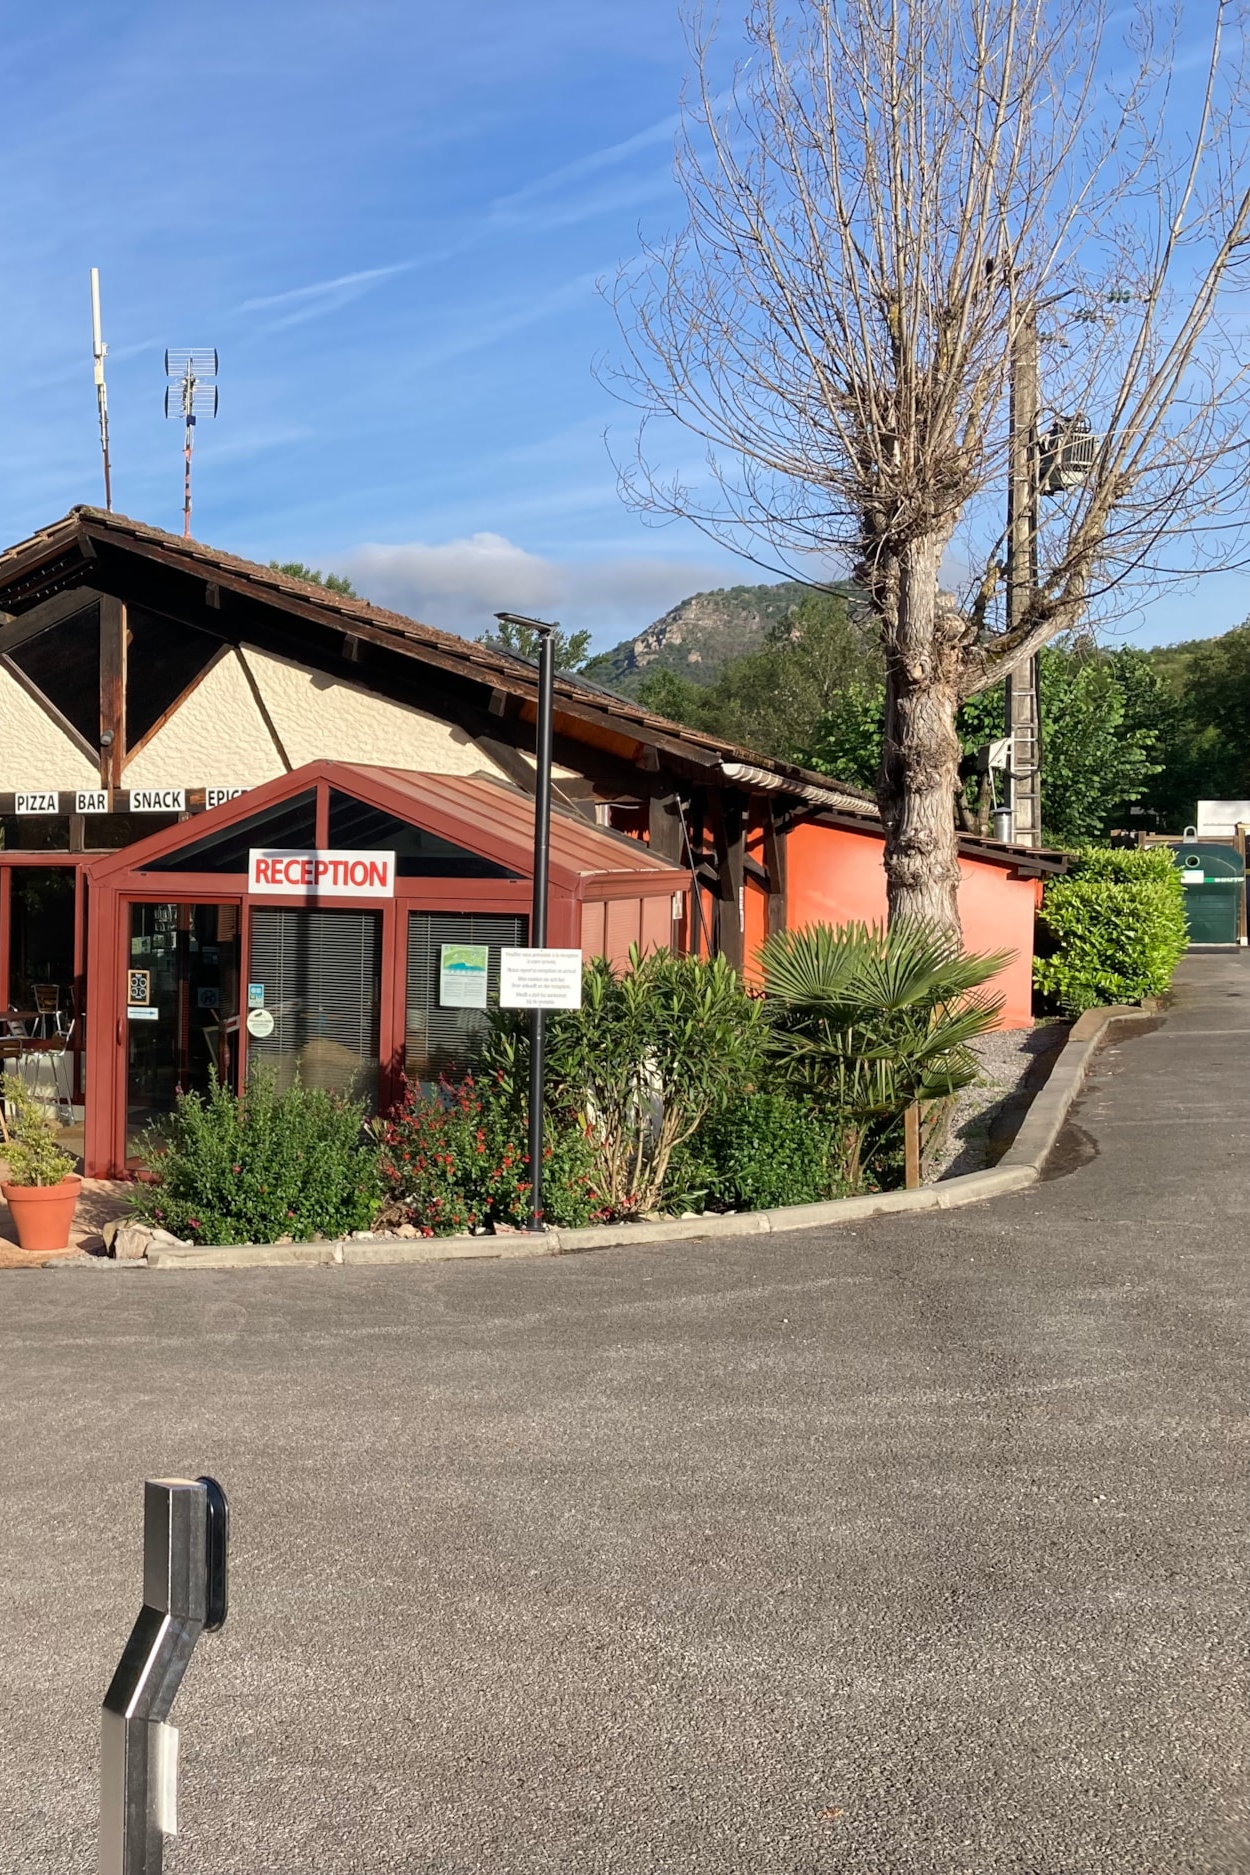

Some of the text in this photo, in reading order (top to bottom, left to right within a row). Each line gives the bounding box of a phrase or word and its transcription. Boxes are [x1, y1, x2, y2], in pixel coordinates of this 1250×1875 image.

[17, 795, 56, 811] PIZZA
[78, 794, 105, 810] BAR
[133, 791, 181, 809] SNACK
[208, 789, 247, 807] EPIC
[255, 858, 387, 887] RECEPTION
